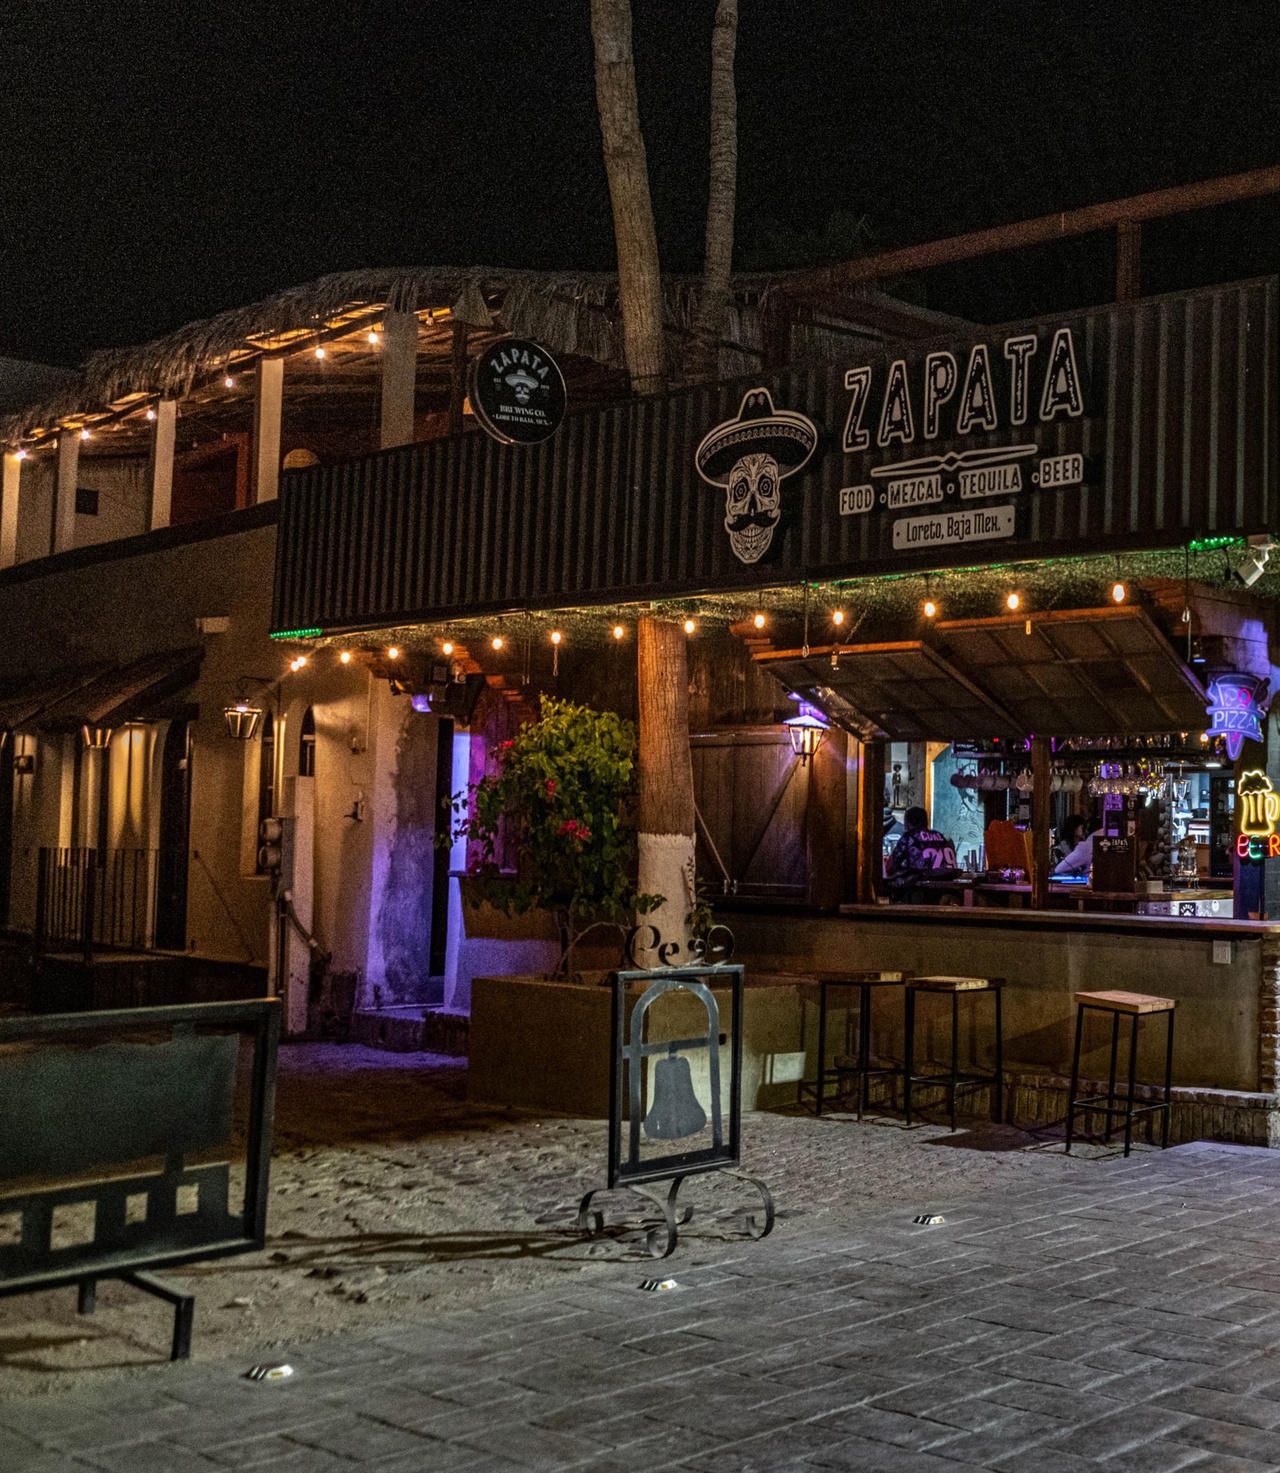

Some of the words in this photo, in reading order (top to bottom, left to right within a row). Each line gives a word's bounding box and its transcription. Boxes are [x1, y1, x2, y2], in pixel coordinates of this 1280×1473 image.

[491, 348, 549, 379] ZAPATA
[843, 328, 1083, 452] ZAPATA
[500, 405, 533, 416] BREWING
[841, 489, 873, 513] FOOD
[889, 476, 942, 506] MEZCAL
[961, 468, 1021, 496] TEQUILA
[1043, 457, 1082, 484] BEER
[906, 522, 945, 542] Loreto,
[947, 515, 971, 540] Baja
[974, 512, 1001, 534] Mex.
[1214, 710, 1258, 730] PIZZA
